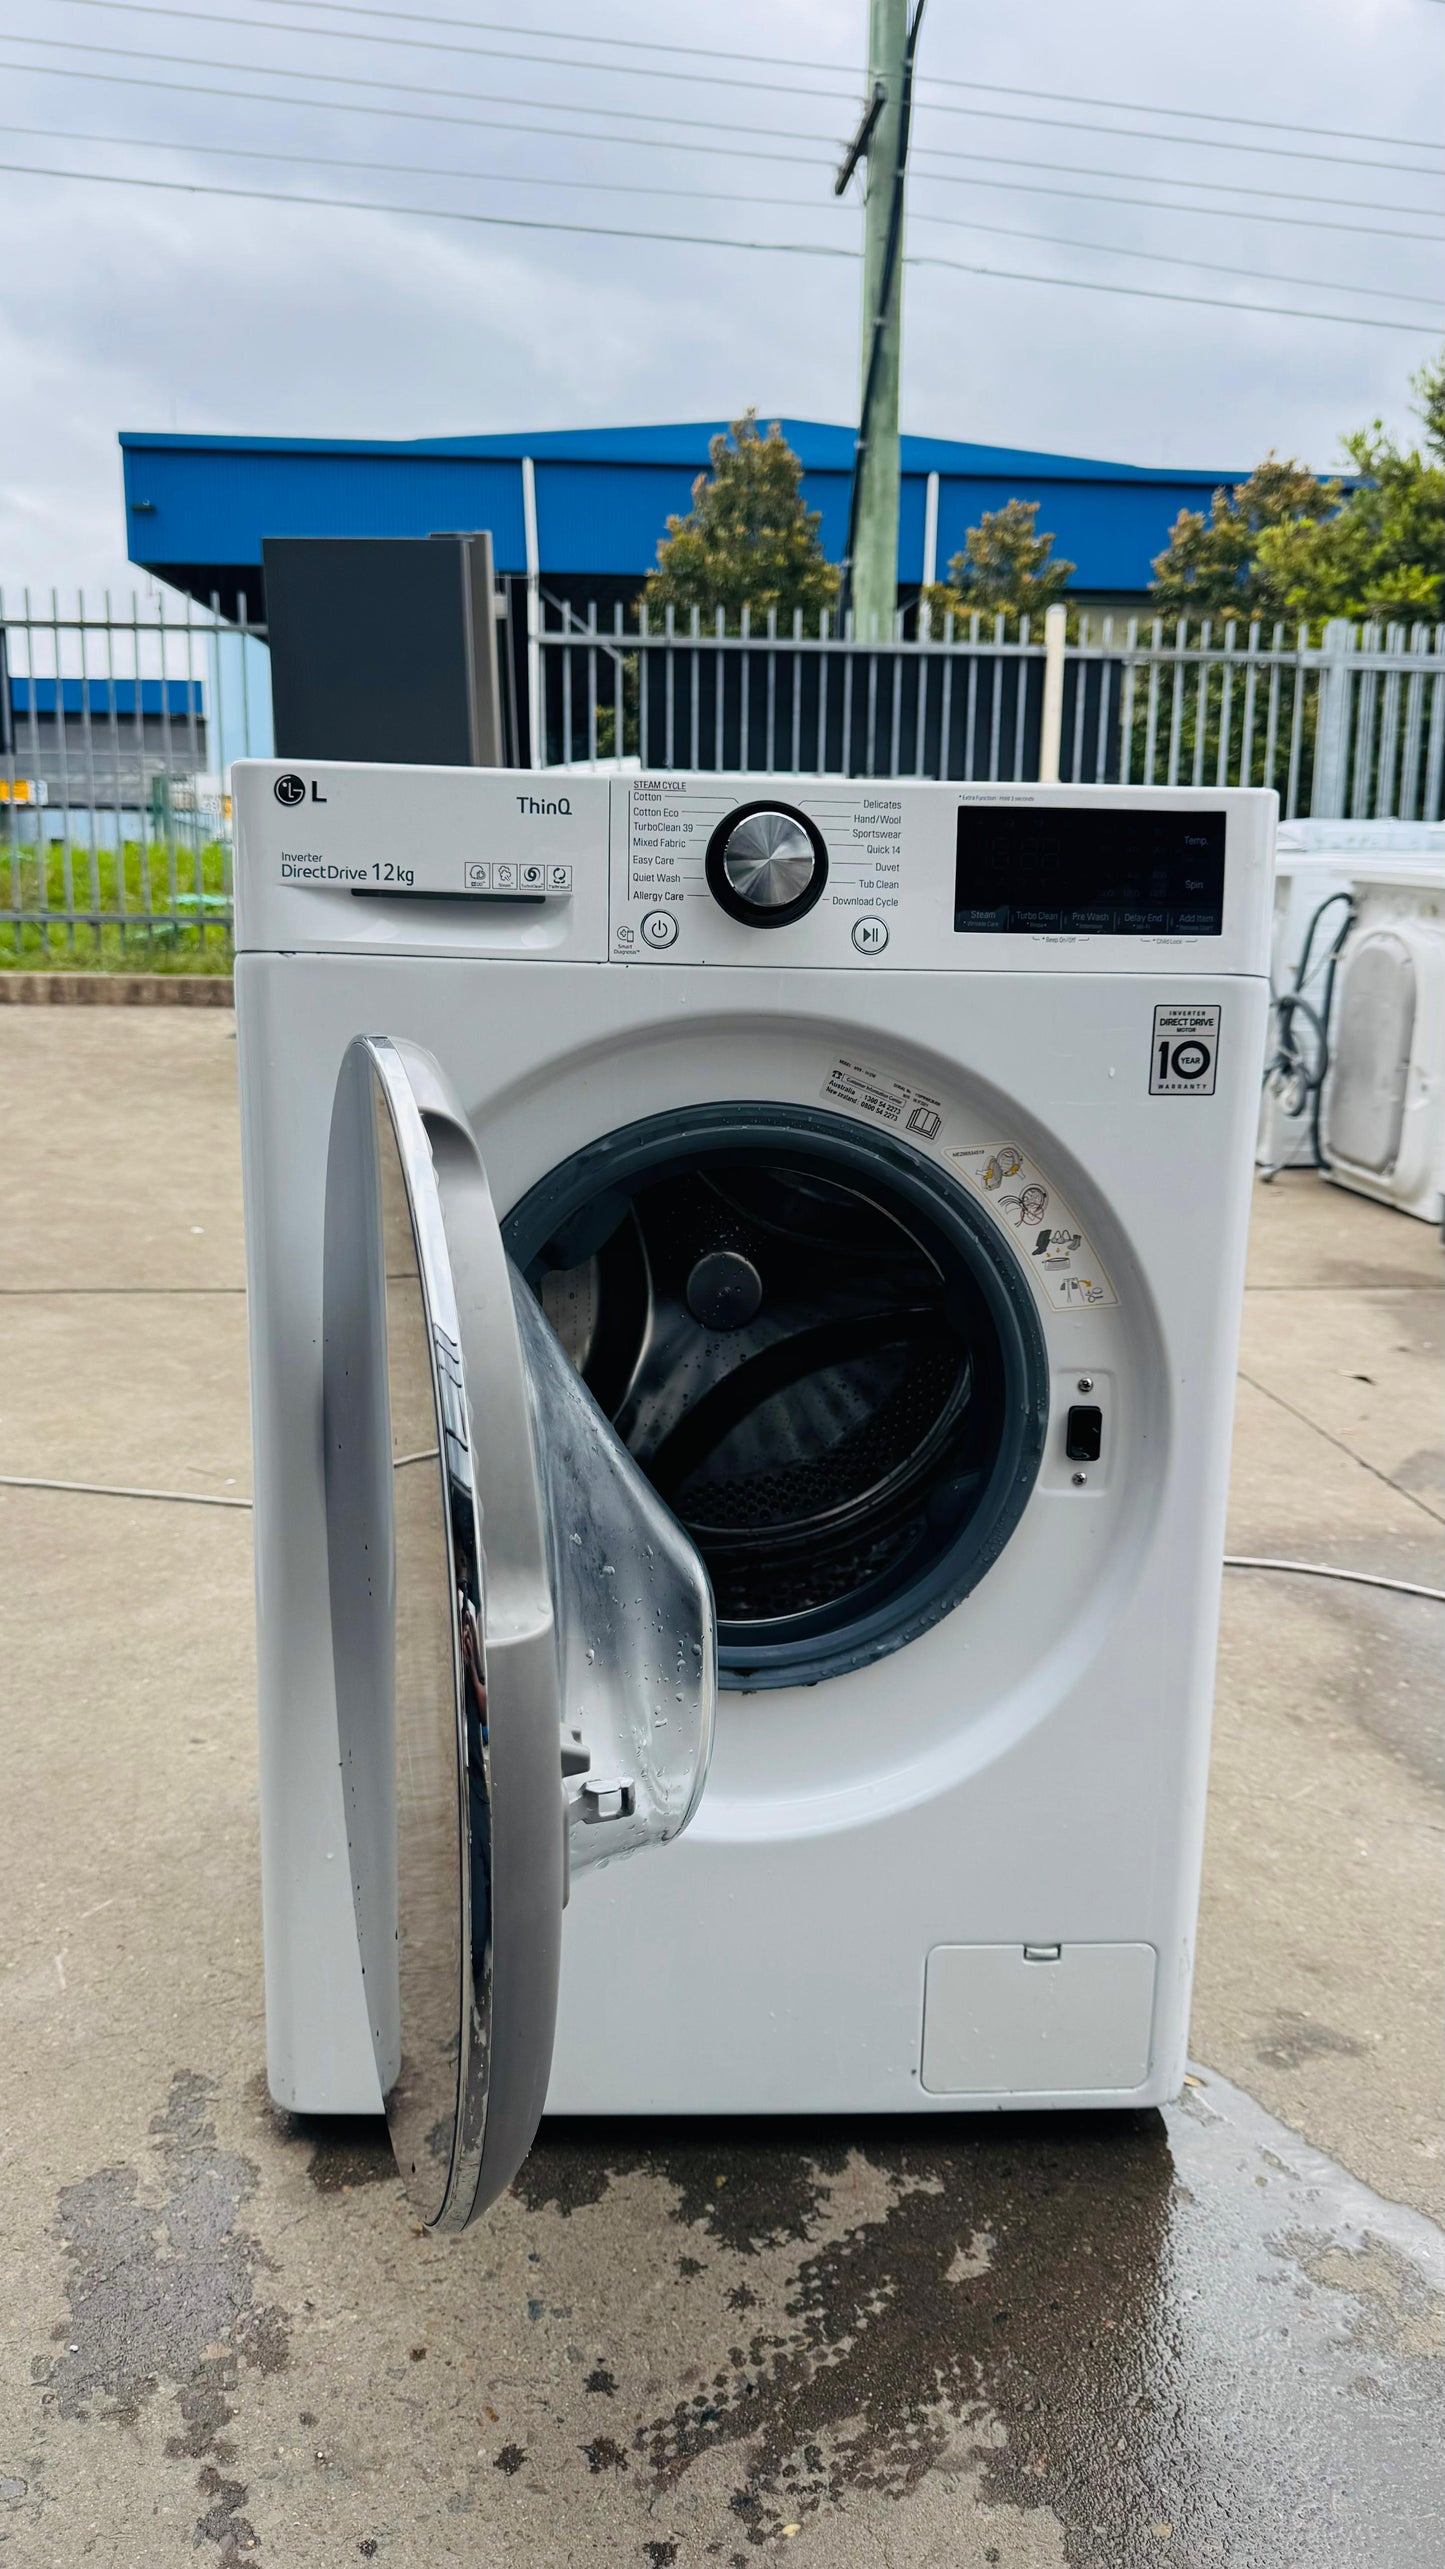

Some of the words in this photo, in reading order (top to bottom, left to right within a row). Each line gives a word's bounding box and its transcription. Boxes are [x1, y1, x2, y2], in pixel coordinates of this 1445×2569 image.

[633, 781, 661, 790] STEAM
[663, 782, 686, 790] CYCLE
[312, 780, 327, 802] L
[633, 792, 662, 802] Cotton
[517, 796, 572, 816] ThinQ
[863, 800, 902, 809] Delicates
[633, 808, 661, 817] Cotton
[663, 808, 679, 817] Eco
[854, 815, 902, 825] Hand/Wool
[633, 822, 680, 832] TurboClean
[682, 823, 694, 832] 39
[852, 829, 901, 840] Sportswear
[633, 838, 658, 848] Mixed
[660, 838, 686, 848] Fabric
[1184, 836, 1208, 847] Temp.
[867, 845, 889, 855] Quick
[891, 846, 901, 854] 14
[281, 852, 323, 863] Inverter
[633, 856, 653, 866] Easy
[654, 856, 675, 865] Care
[875, 863, 900, 872] Duvet
[372, 863, 415, 886] 12kg
[633, 873, 654, 883] Quiet
[656, 874, 681, 883] Wash
[859, 880, 874, 889] Tub
[876, 880, 899, 889] Clean
[1184, 880, 1204, 891] Spin
[633, 891, 663, 902] Allergy
[665, 892, 684, 901] Care
[832, 897, 874, 906] Download
[876, 898, 899, 908] Cycle
[971, 910, 996, 919] Steam
[1016, 911, 1037, 921] Turbo
[1038, 912, 1058, 921] Clean
[1072, 912, 1084, 921] Pre
[1086, 913, 1109, 922] Wash
[1124, 913, 1144, 924] Delay
[1146, 914, 1163, 923] End
[1179, 914, 1196, 923] Add
[1158, 1040, 1210, 1079] 10
[828, 1080, 856, 1095] Australia
[864, 1095, 878, 1105] 1300
[886, 1105, 901, 1114] 2273
[826, 1086, 838, 1096] New
[876, 1108, 884, 1116] 54
[883, 1112, 898, 1121] 2273
